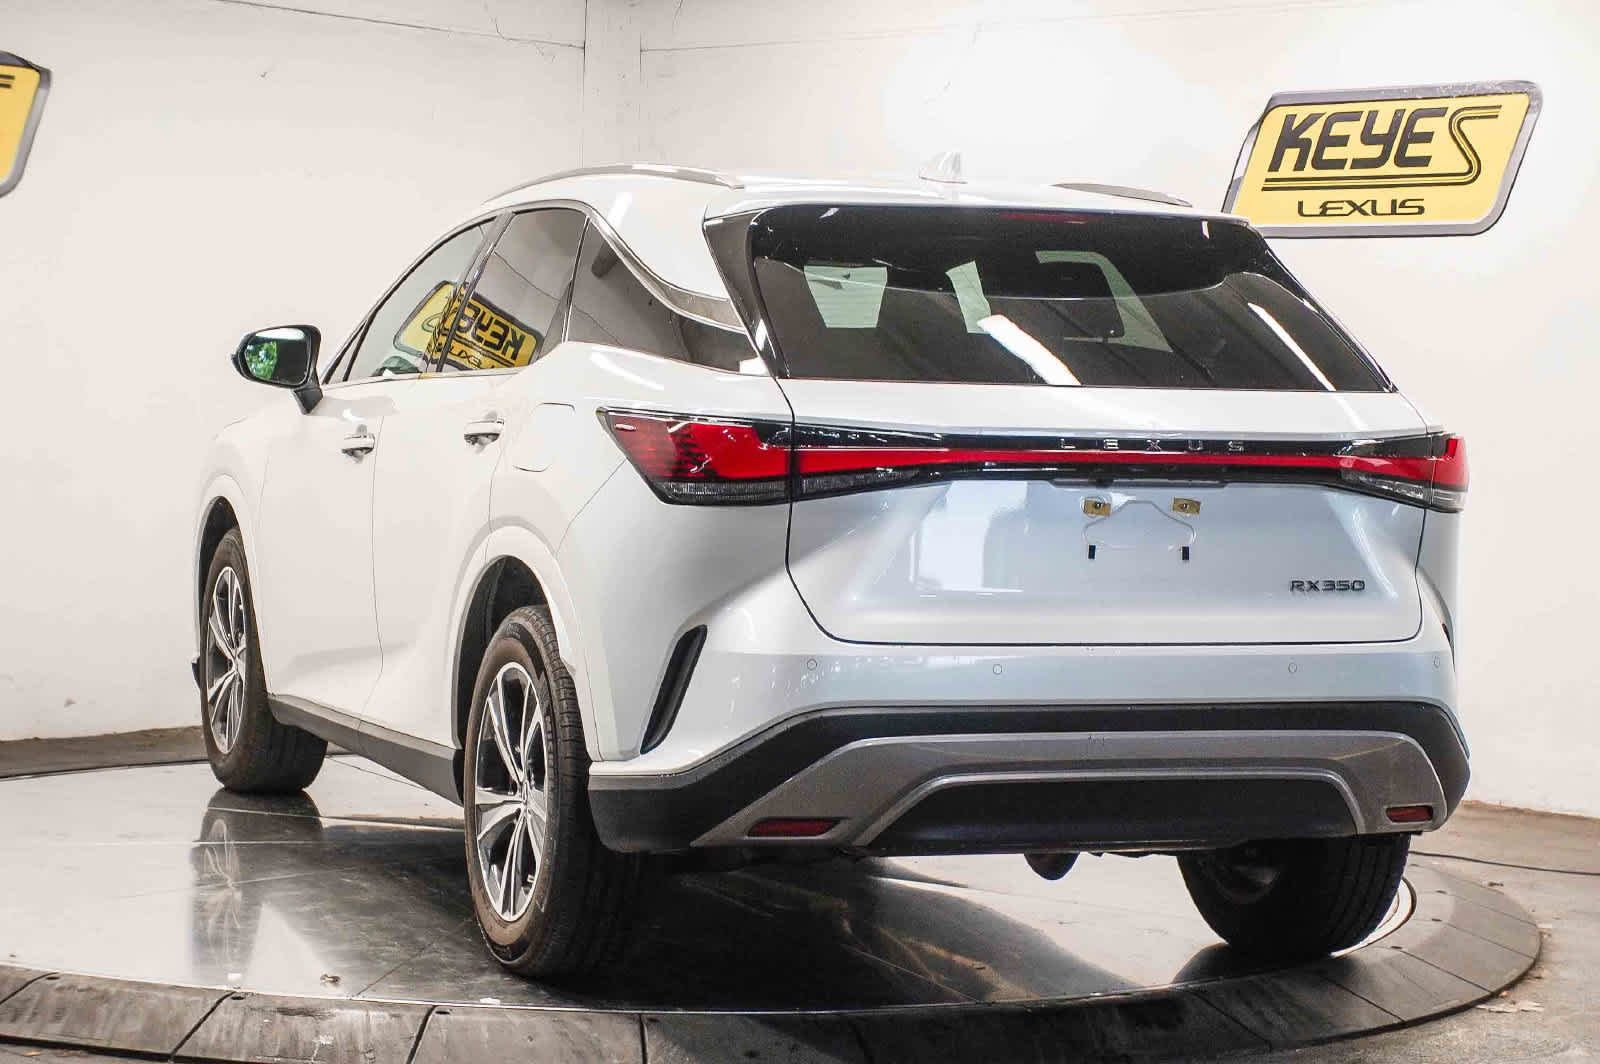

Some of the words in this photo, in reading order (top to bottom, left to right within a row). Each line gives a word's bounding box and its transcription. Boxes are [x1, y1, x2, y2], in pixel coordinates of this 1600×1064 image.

[1265, 104, 1503, 185] KEYES
[1297, 198, 1425, 217] LEXUS
[1060, 438, 1245, 451] LEXUS
